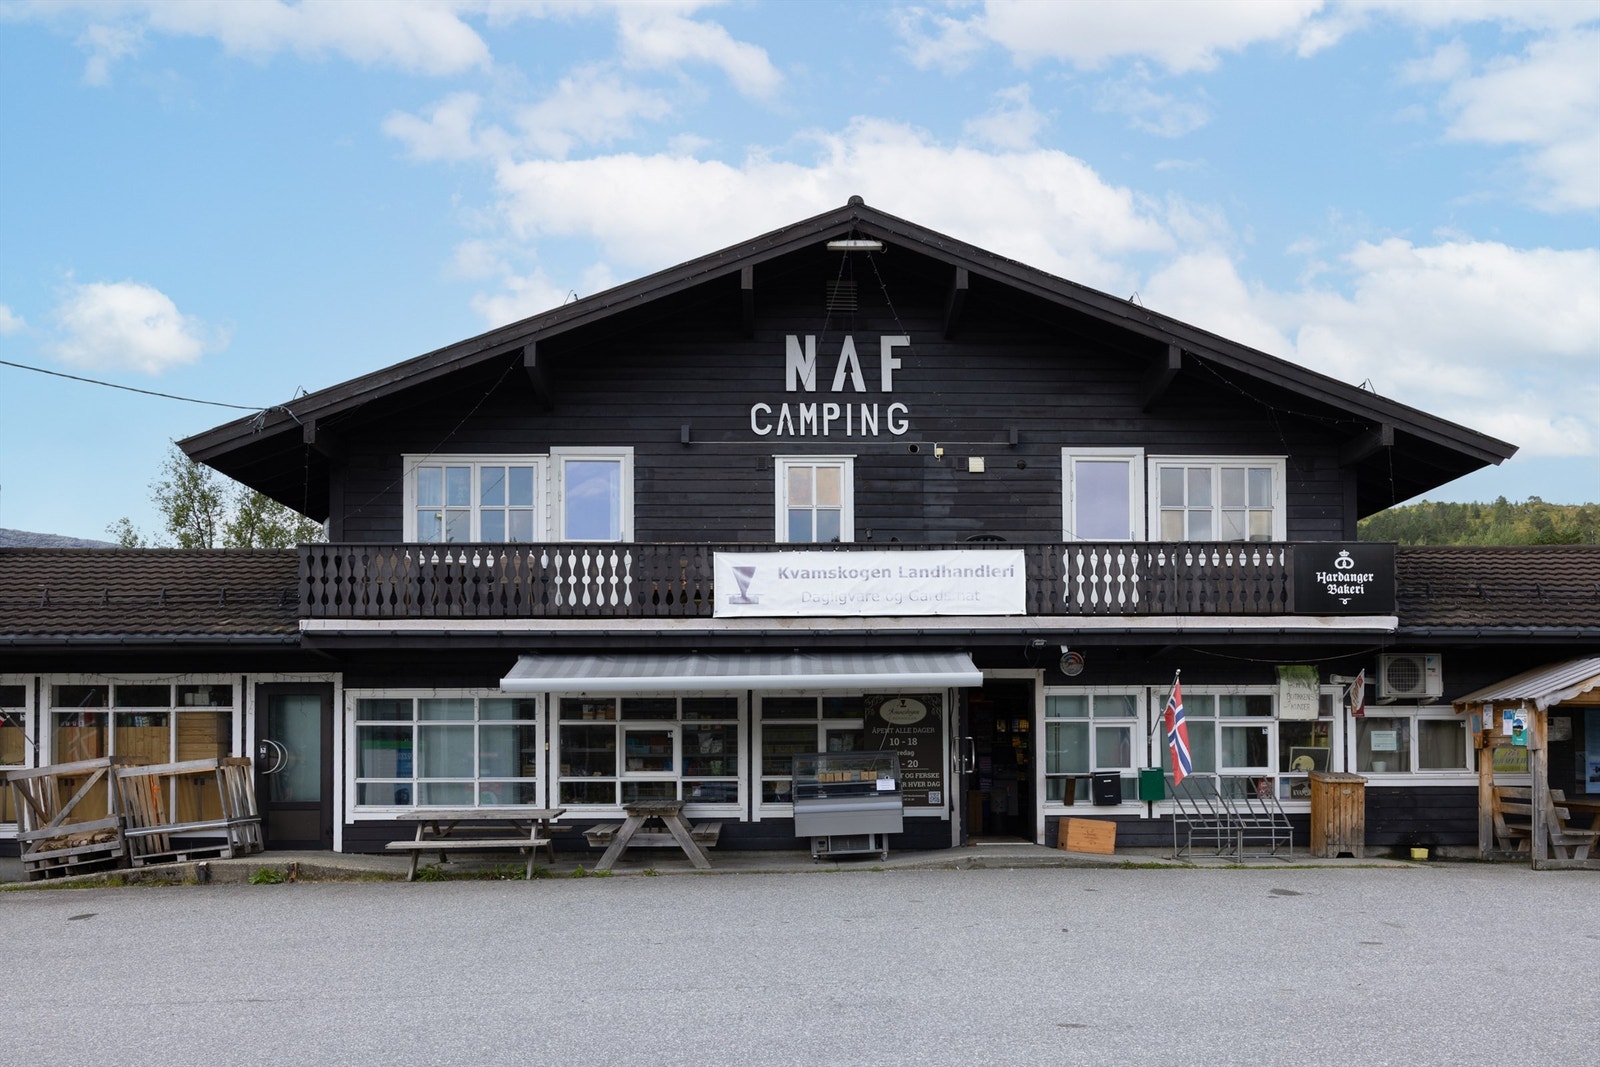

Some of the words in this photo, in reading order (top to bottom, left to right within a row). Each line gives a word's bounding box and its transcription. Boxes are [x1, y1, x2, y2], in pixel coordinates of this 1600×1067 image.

[785, 335, 911, 393] NAF
[750, 402, 910, 436] CAMPING
[778, 566, 892, 582] Kvamskogen
[899, 564, 1015, 579] Landhandleri
[1316, 571, 1374, 584] Hardanger
[1327, 584, 1364, 595] Bakeri
[801, 590, 880, 605] Dagligvare
[885, 591, 903, 604] og
[889, 737, 900, 746] 10
[907, 737, 918, 746] 18
[897, 749, 915, 757] redag
[907, 759, 919, 768] 20
